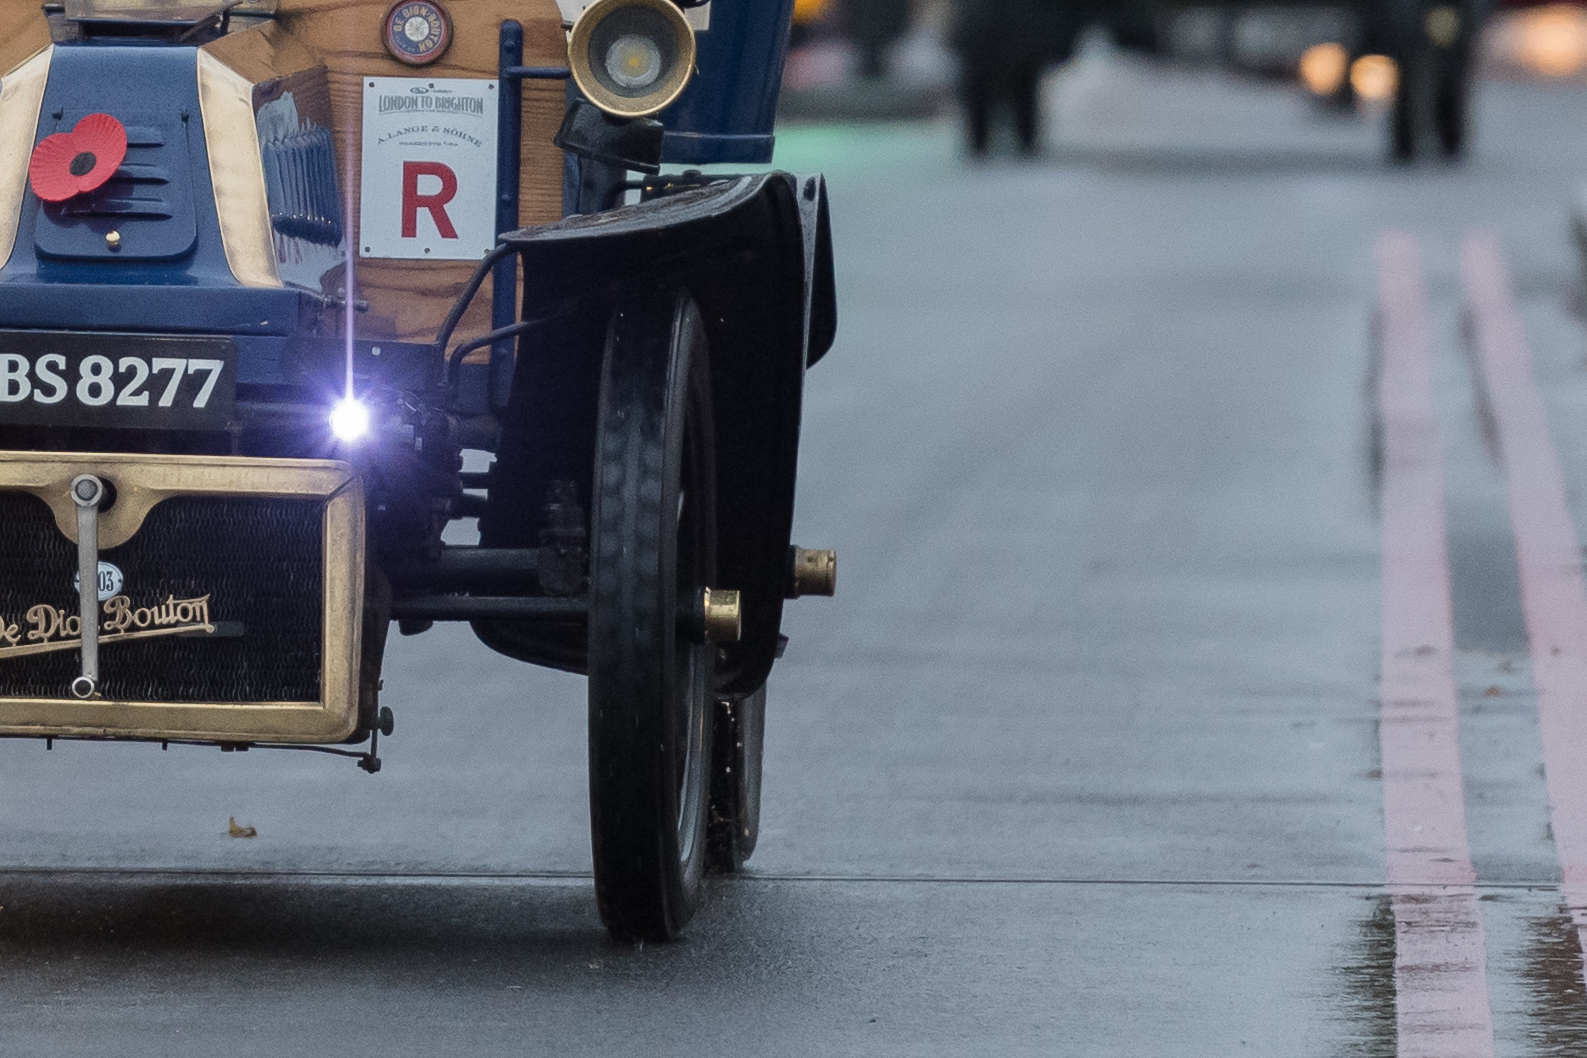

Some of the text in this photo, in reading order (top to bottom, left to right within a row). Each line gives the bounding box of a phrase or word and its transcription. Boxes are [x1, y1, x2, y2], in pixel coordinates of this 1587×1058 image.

[378, 94, 484, 115] LONDON TO BRIGHTON
[401, 160, 459, 240] R
[26, 603, 100, 641] Dio
[103, 593, 211, 632] Bouton
